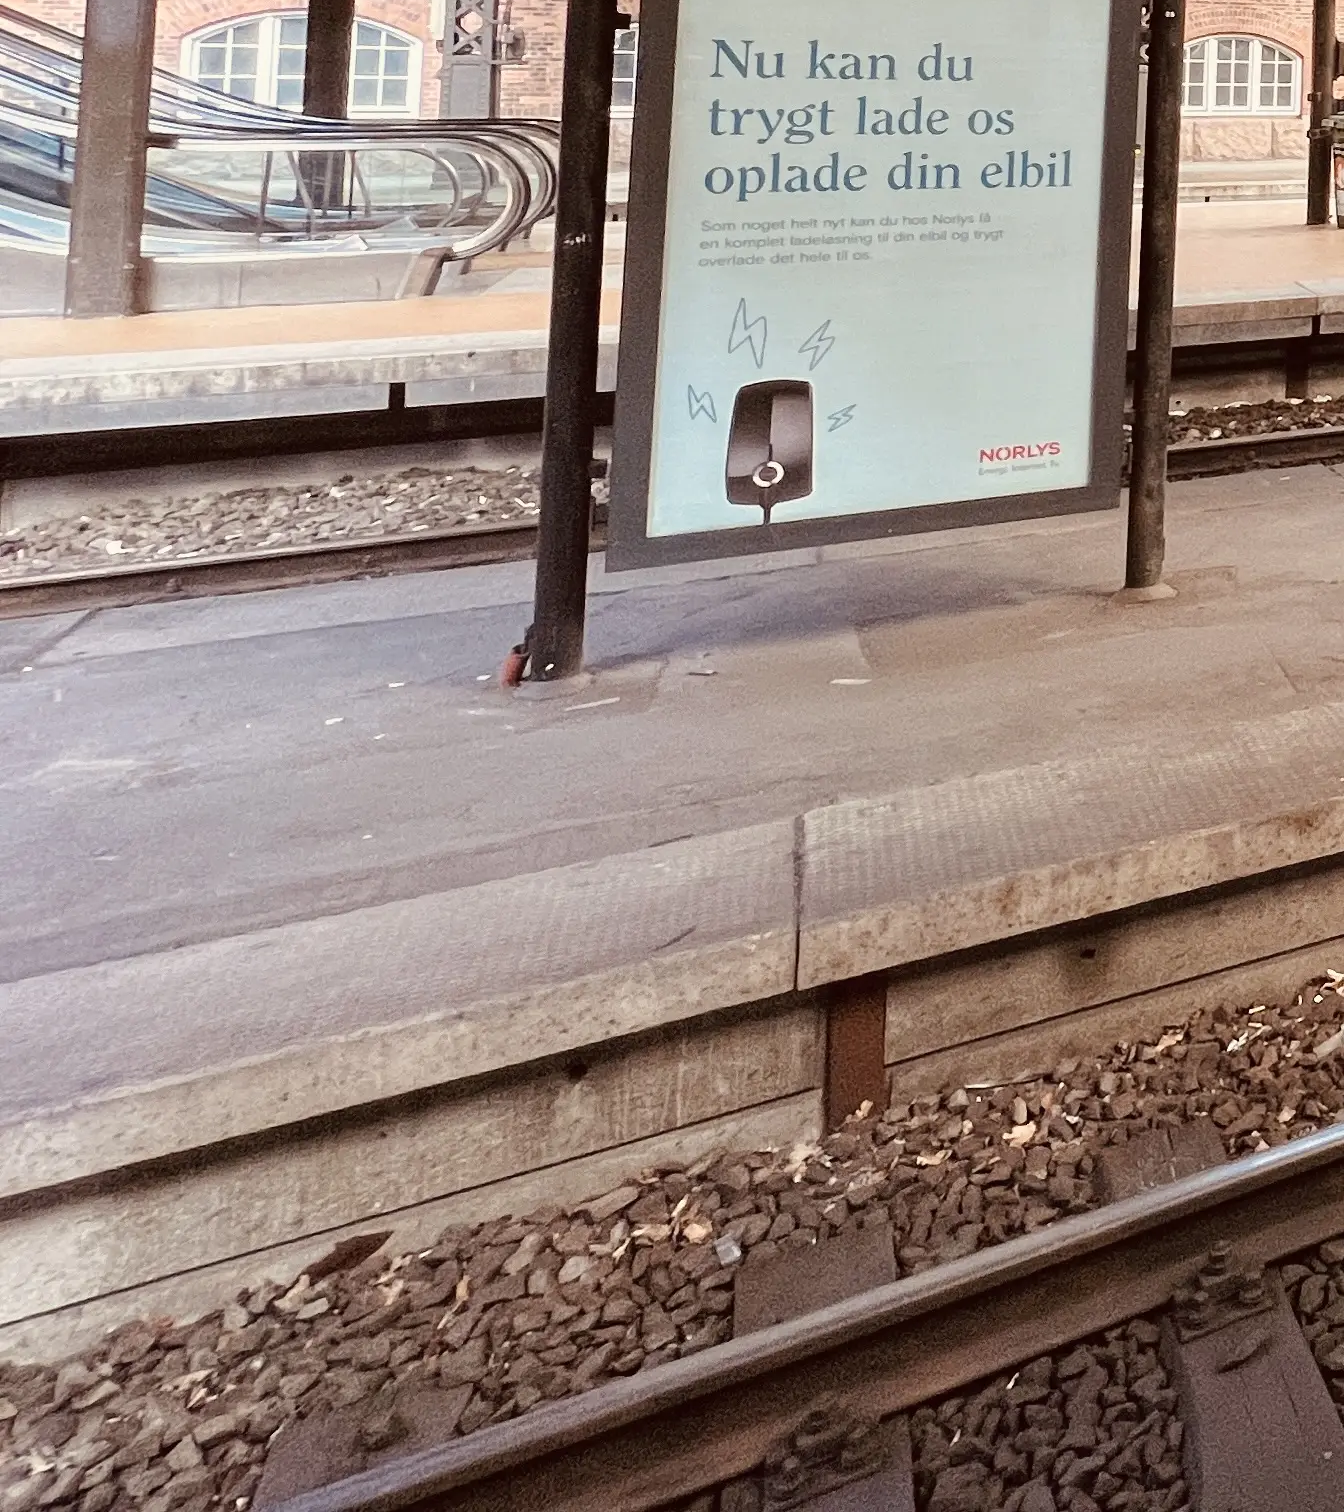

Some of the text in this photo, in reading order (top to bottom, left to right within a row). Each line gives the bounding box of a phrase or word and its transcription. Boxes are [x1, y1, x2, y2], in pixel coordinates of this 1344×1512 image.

[709, 39, 975, 82] Nu kan du
[708, 95, 1015, 144] trygt lade os
[704, 149, 1073, 203] oplade din elbil
[701, 212, 992, 233] Som noget helt nyt kan du hos Norlys få
[699, 228, 1005, 251] en komplet ladeløsning til din elbil og trygt
[698, 253, 766, 268] overlade
[769, 251, 795, 265] det
[800, 251, 831, 263] hele
[836, 250, 848, 261] til
[979, 441, 1061, 464] NORLYS
